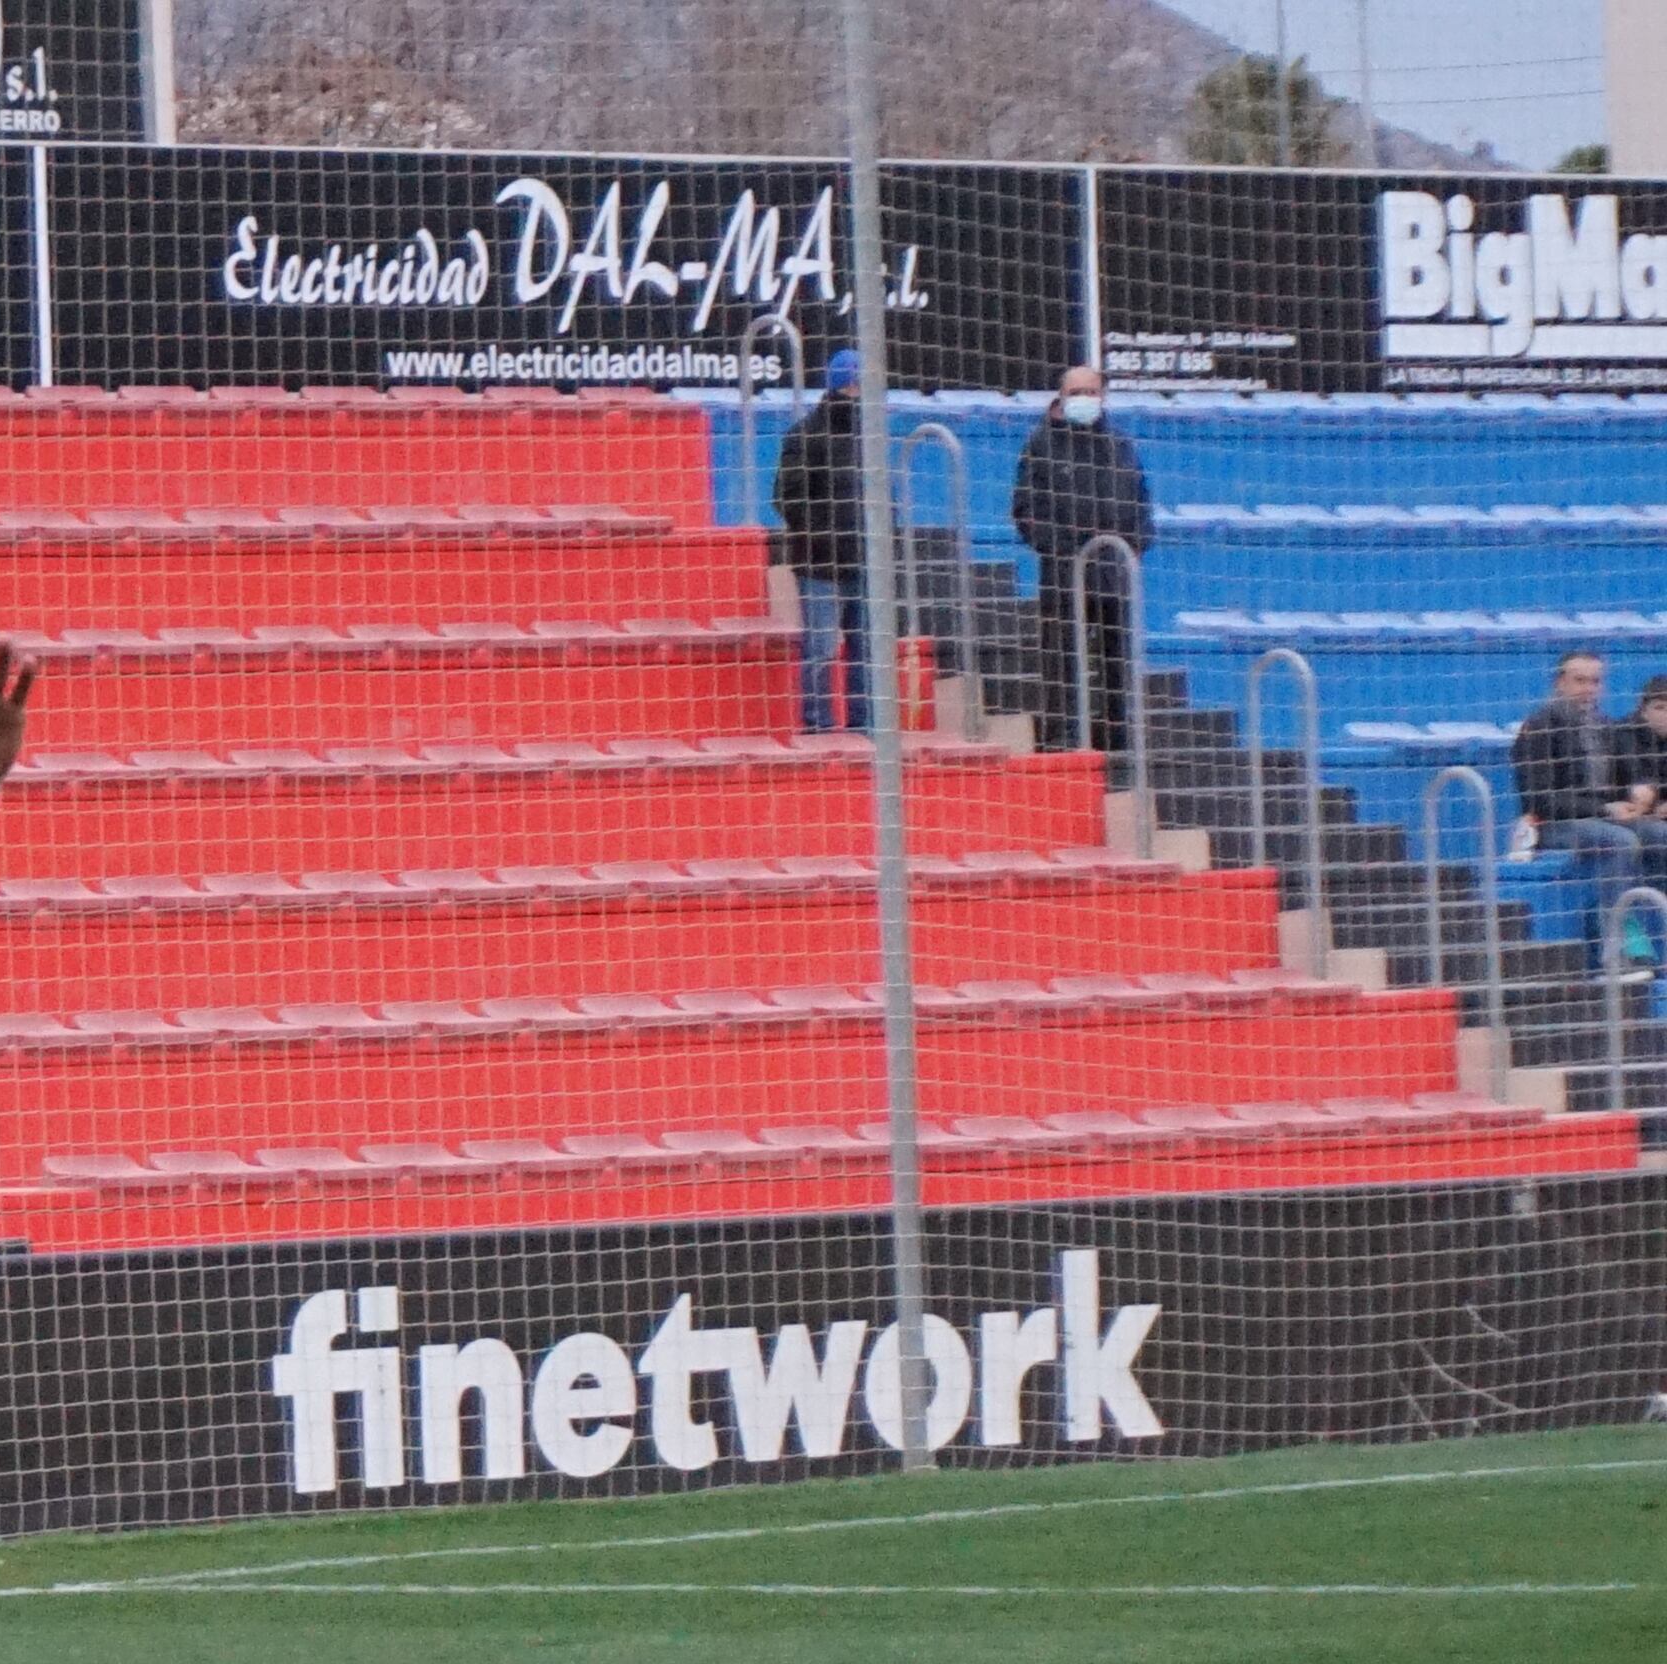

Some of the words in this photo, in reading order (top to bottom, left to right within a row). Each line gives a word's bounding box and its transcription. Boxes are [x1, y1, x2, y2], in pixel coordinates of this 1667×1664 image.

[225, 215, 489, 305] Electricidad
[387, 345, 783, 382] www.electricidaddalmaes
[273, 1250, 1165, 1494] finetwork
